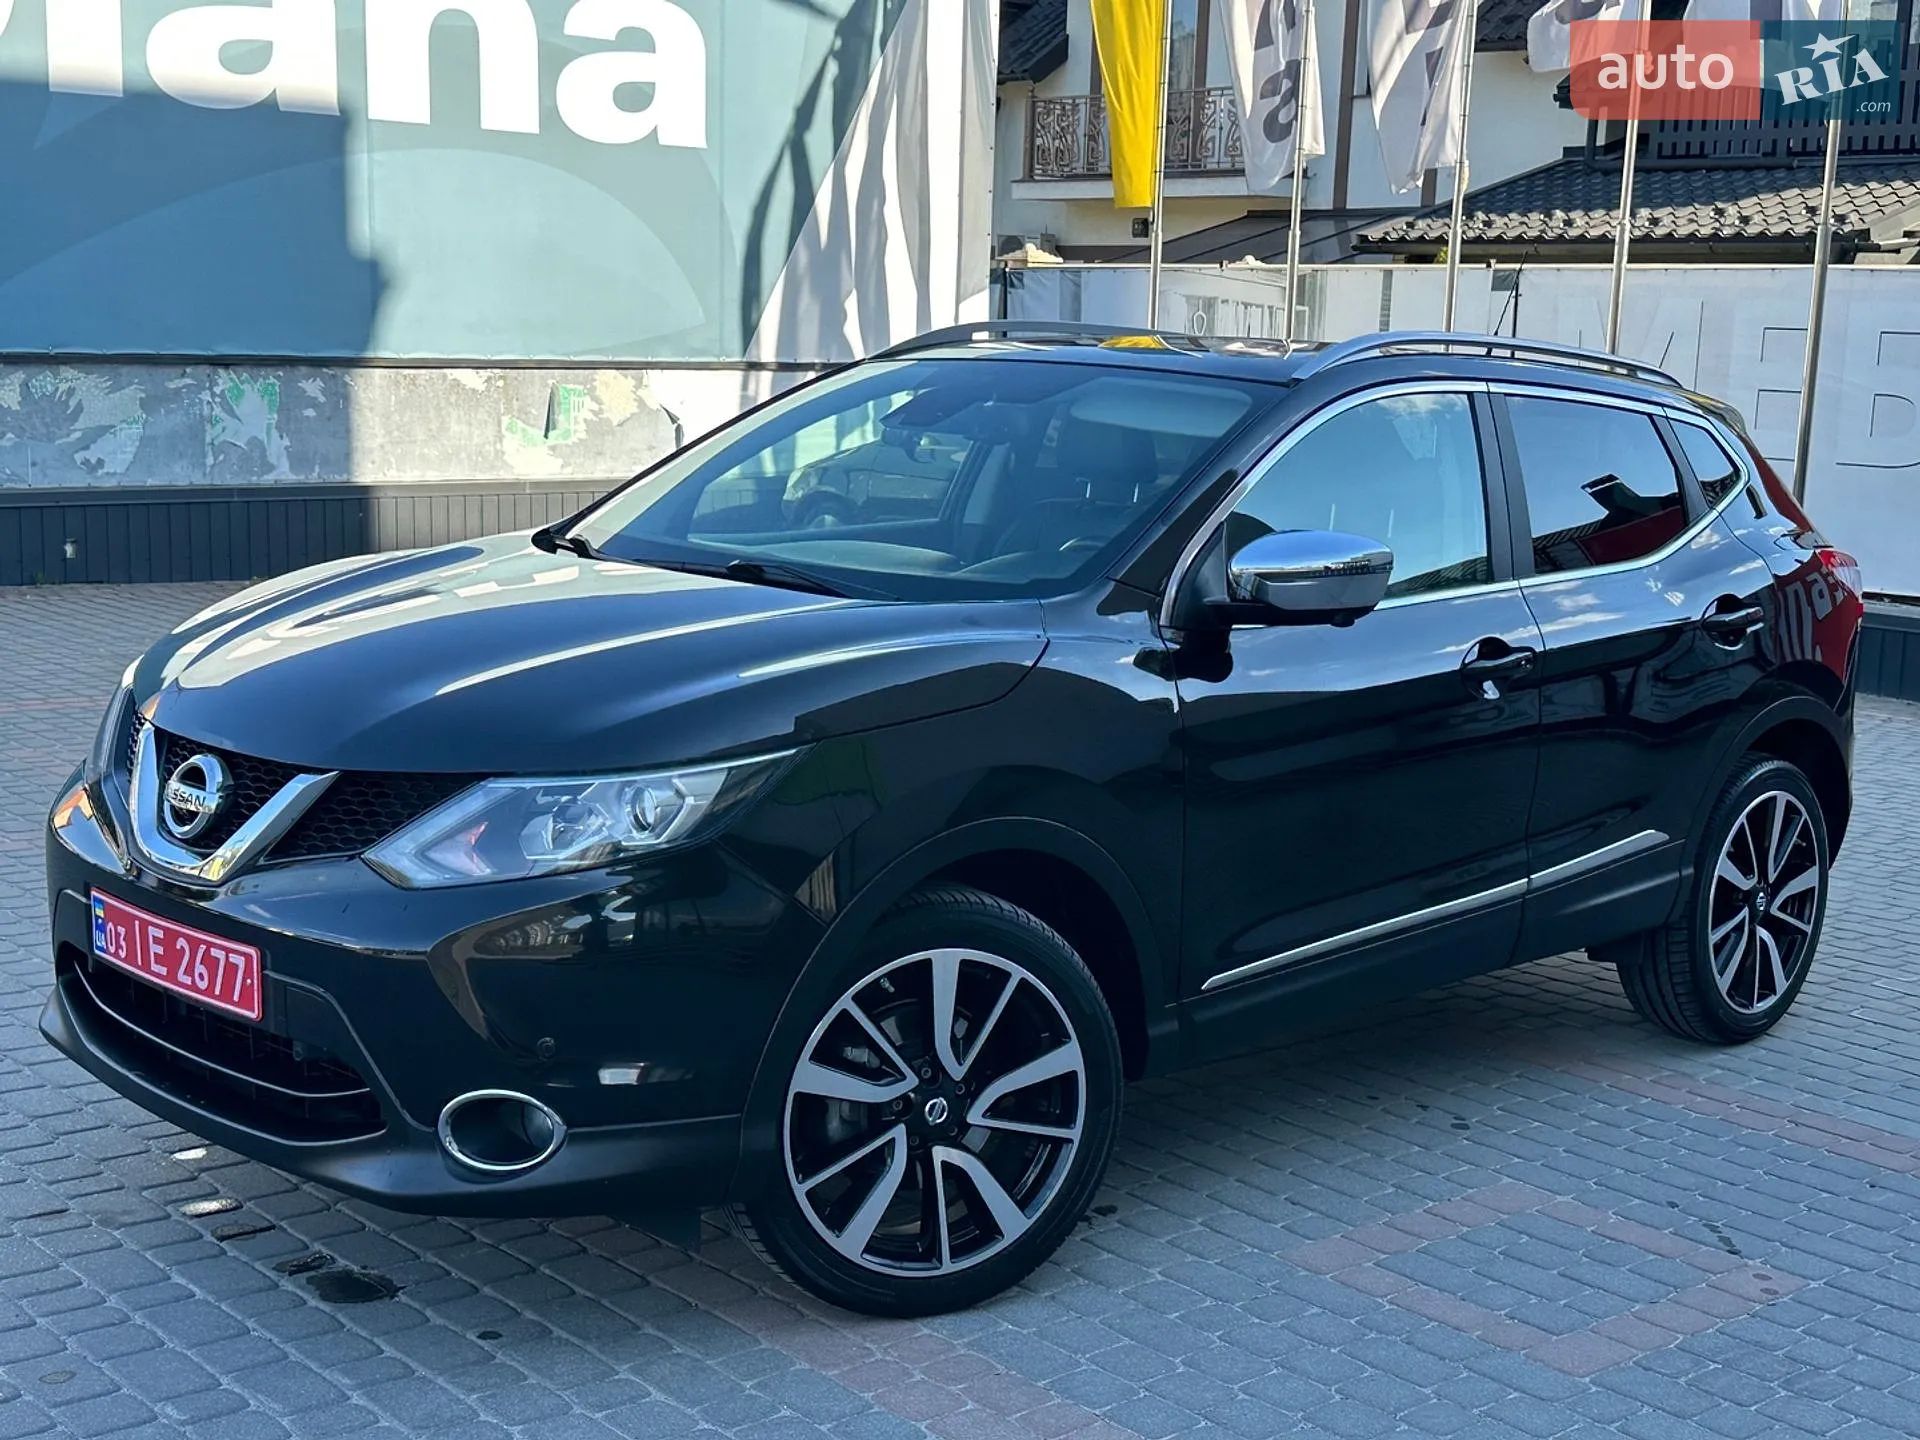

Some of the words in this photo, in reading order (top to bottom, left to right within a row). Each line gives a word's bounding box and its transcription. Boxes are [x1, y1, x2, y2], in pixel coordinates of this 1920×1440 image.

[167, 784, 207, 808] SSAN
[106, 922, 127, 959] 03
[175, 937, 245, 1002] 2677
